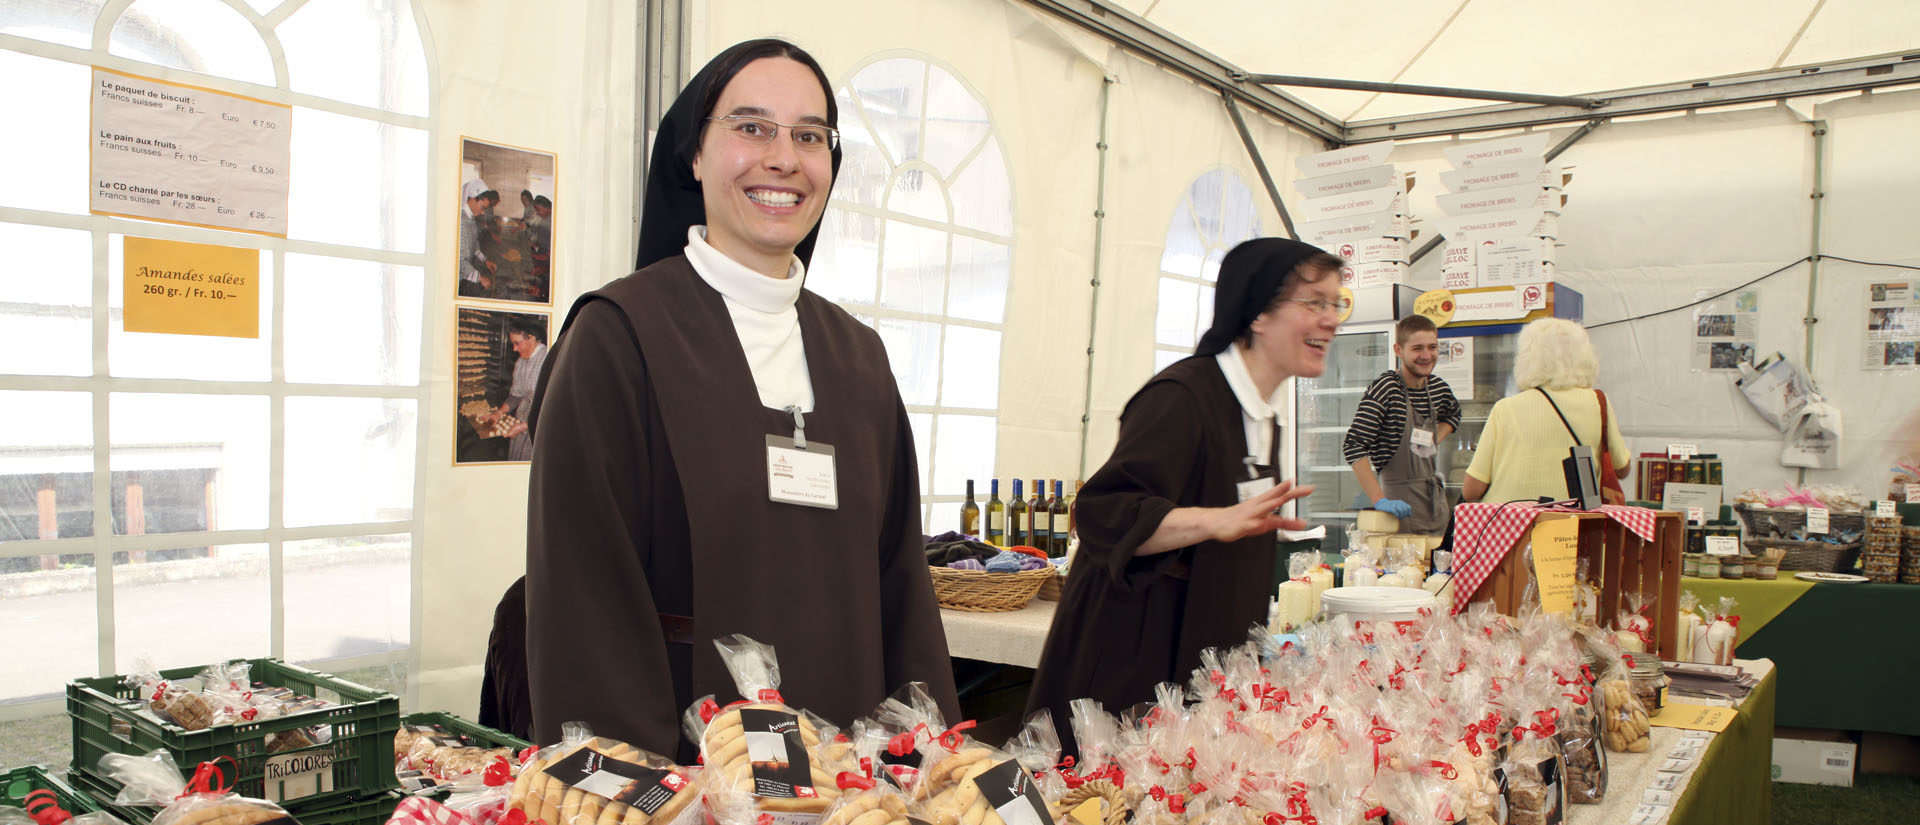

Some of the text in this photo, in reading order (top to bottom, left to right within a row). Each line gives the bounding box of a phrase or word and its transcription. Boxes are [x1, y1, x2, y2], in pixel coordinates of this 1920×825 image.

[102, 80, 112, 88] Le
[115, 84, 145, 96] paquet
[147, 90, 158, 98] de
[160, 92, 190, 104] biscuit
[101, 90, 130, 102] Francs
[132, 97, 163, 109] suisses
[176, 104, 187, 113] Fr.
[222, 113, 239, 122] Euro
[101, 131, 112, 139] Le
[114, 133, 134, 143] pain
[136, 137, 151, 145] aux
[154, 139, 176, 150] fruits
[100, 140, 129, 152] Francs
[131, 147, 162, 157] suisses
[174, 152, 185, 160] Fr.
[220, 160, 237, 169] Euro
[1318, 160, 1342, 168] FROMAGE
[100, 180, 111, 189] Le
[113, 182, 127, 191] CD
[129, 184, 158, 195] chanté
[161, 190, 174, 199] par
[176, 191, 189, 200] les
[99, 191, 127, 201] Francs
[130, 196, 160, 206] suisses
[173, 200, 185, 208] Fr.
[217, 206, 235, 216] Euro
[136, 266, 246, 285] Amandes salées
[144, 284, 165, 295] 260
[168, 288, 182, 297] gr.
[185, 287, 191, 298] /
[194, 288, 207, 298] Fr.
